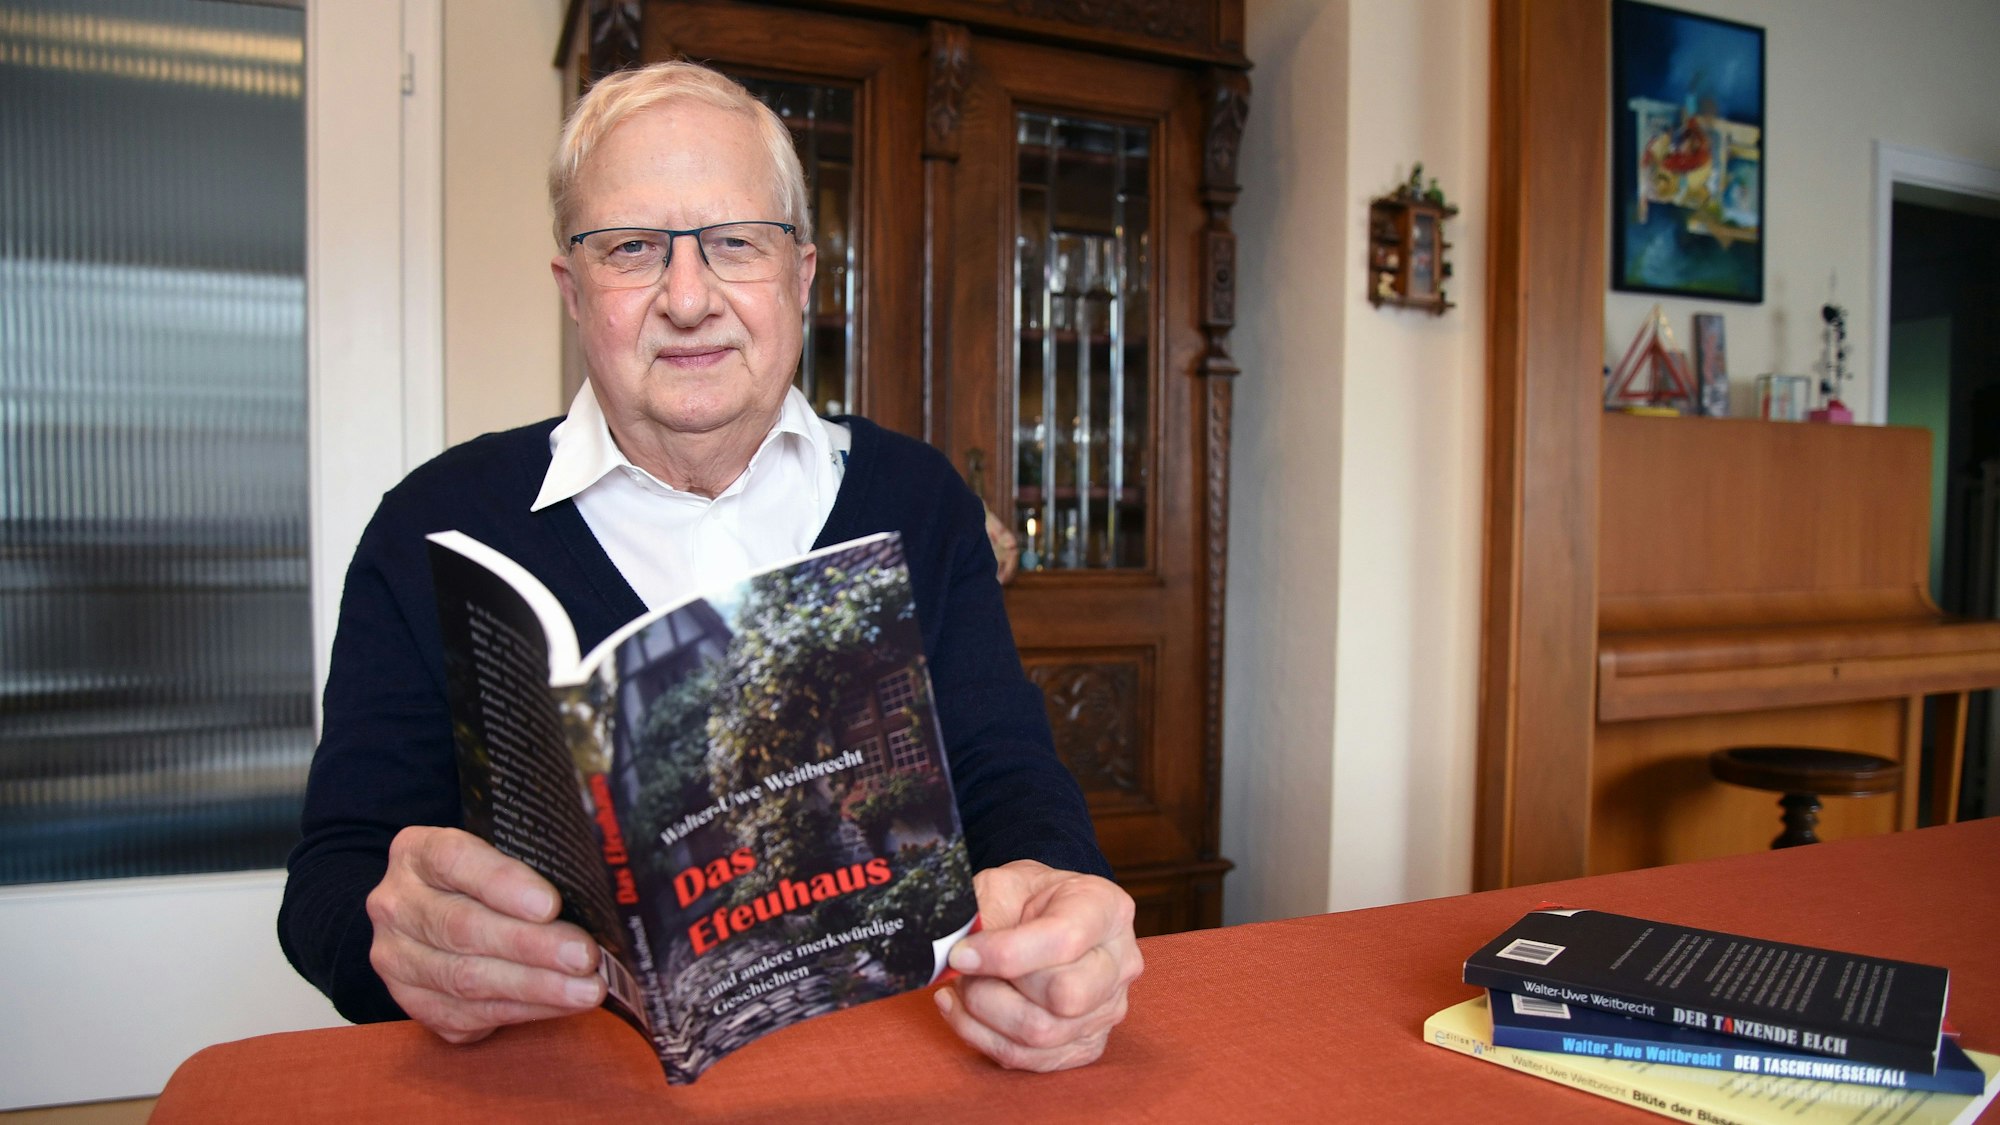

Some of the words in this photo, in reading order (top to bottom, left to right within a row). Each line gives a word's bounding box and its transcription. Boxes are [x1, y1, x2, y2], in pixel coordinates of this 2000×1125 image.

[660, 785, 762, 846] Walter-Uwe
[763, 750, 865, 792] Weitbrecht
[673, 846, 757, 909] Das
[687, 857, 892, 957] Efeuhaus
[708, 974, 737, 999] und
[740, 950, 794, 982] andere
[796, 917, 904, 958] merkwürdige
[712, 965, 810, 1016] Geschichten
[1523, 980, 1588, 1003] Walter-Uwe
[1590, 993, 1655, 1016] Weitbrecht
[1672, 1006, 1708, 1028] DER
[1712, 1014, 1798, 1046] TANZENDE
[1802, 1031, 1848, 1055] ELCH
[1511, 1054, 1567, 1079] Walter-Uwe
[1570, 1069, 1626, 1098] Weitbrecht
[1632, 1089, 1666, 1109] Blüte
[1671, 1102, 1693, 1117] der
[1562, 1037, 1642, 1059] Walter-Uwe
[1646, 1045, 1722, 1067] Weitbrecht
[1733, 1054, 1759, 1072] DER
[1763, 1057, 1907, 1086] TASCHENMESSERFALL
